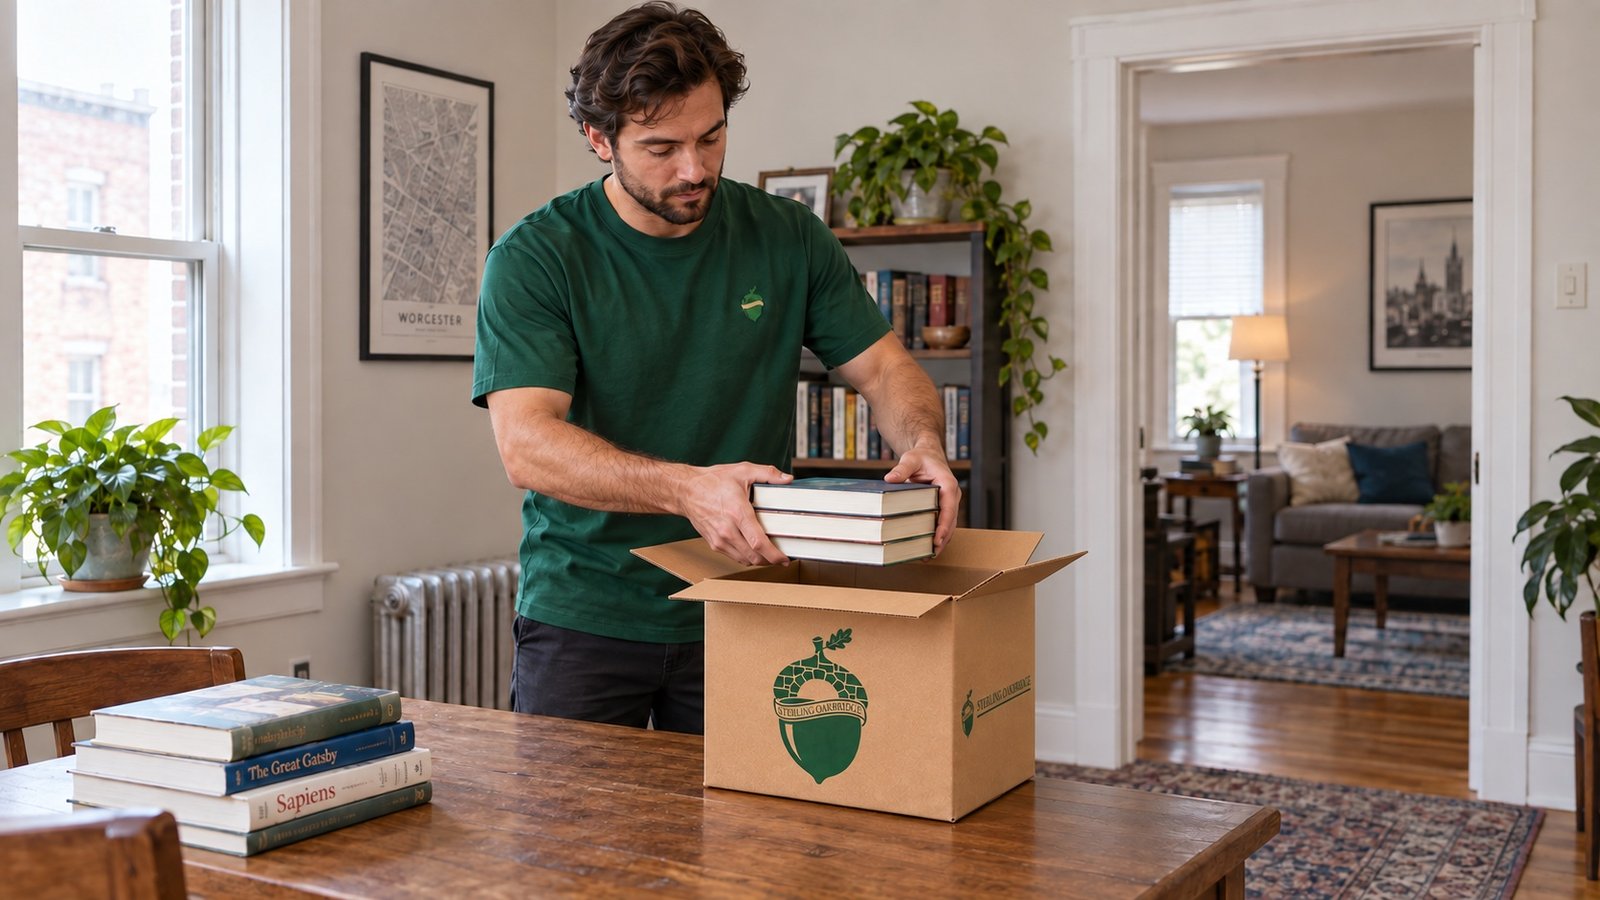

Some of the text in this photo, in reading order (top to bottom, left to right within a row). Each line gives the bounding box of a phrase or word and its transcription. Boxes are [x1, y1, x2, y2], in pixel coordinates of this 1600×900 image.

[398, 312, 462, 326] WORCESTER
[777, 702, 862, 717] STERLING OAKBRIDGE
[248, 748, 338, 780] The Great Gatsby
[276, 785, 336, 814] Sapiens
